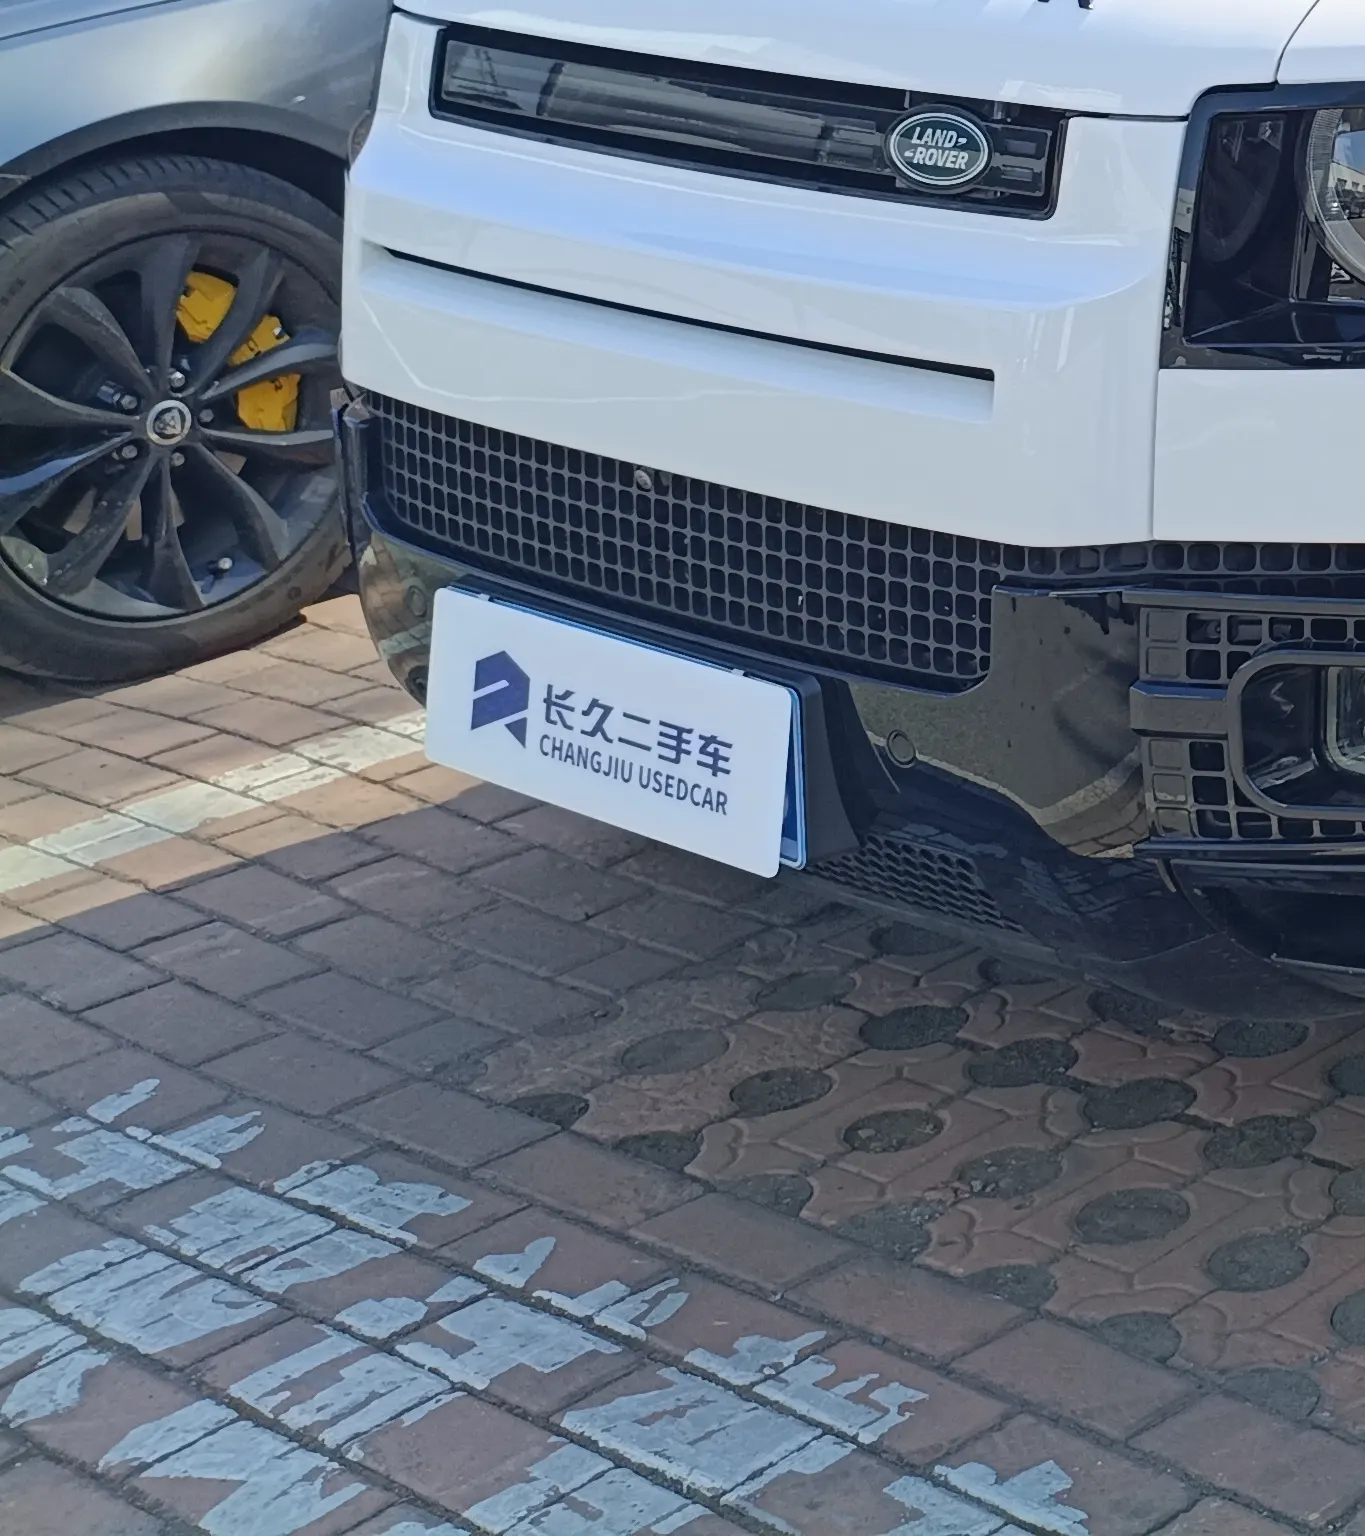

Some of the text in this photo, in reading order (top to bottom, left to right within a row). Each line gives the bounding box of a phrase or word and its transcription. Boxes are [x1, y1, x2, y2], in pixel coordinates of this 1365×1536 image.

[911, 126, 959, 149] LAND
[913, 146, 970, 170] ROVER
[543, 683, 734, 778] 长久二手车
[539, 733, 729, 816] CHANGJIU USEDCAR
